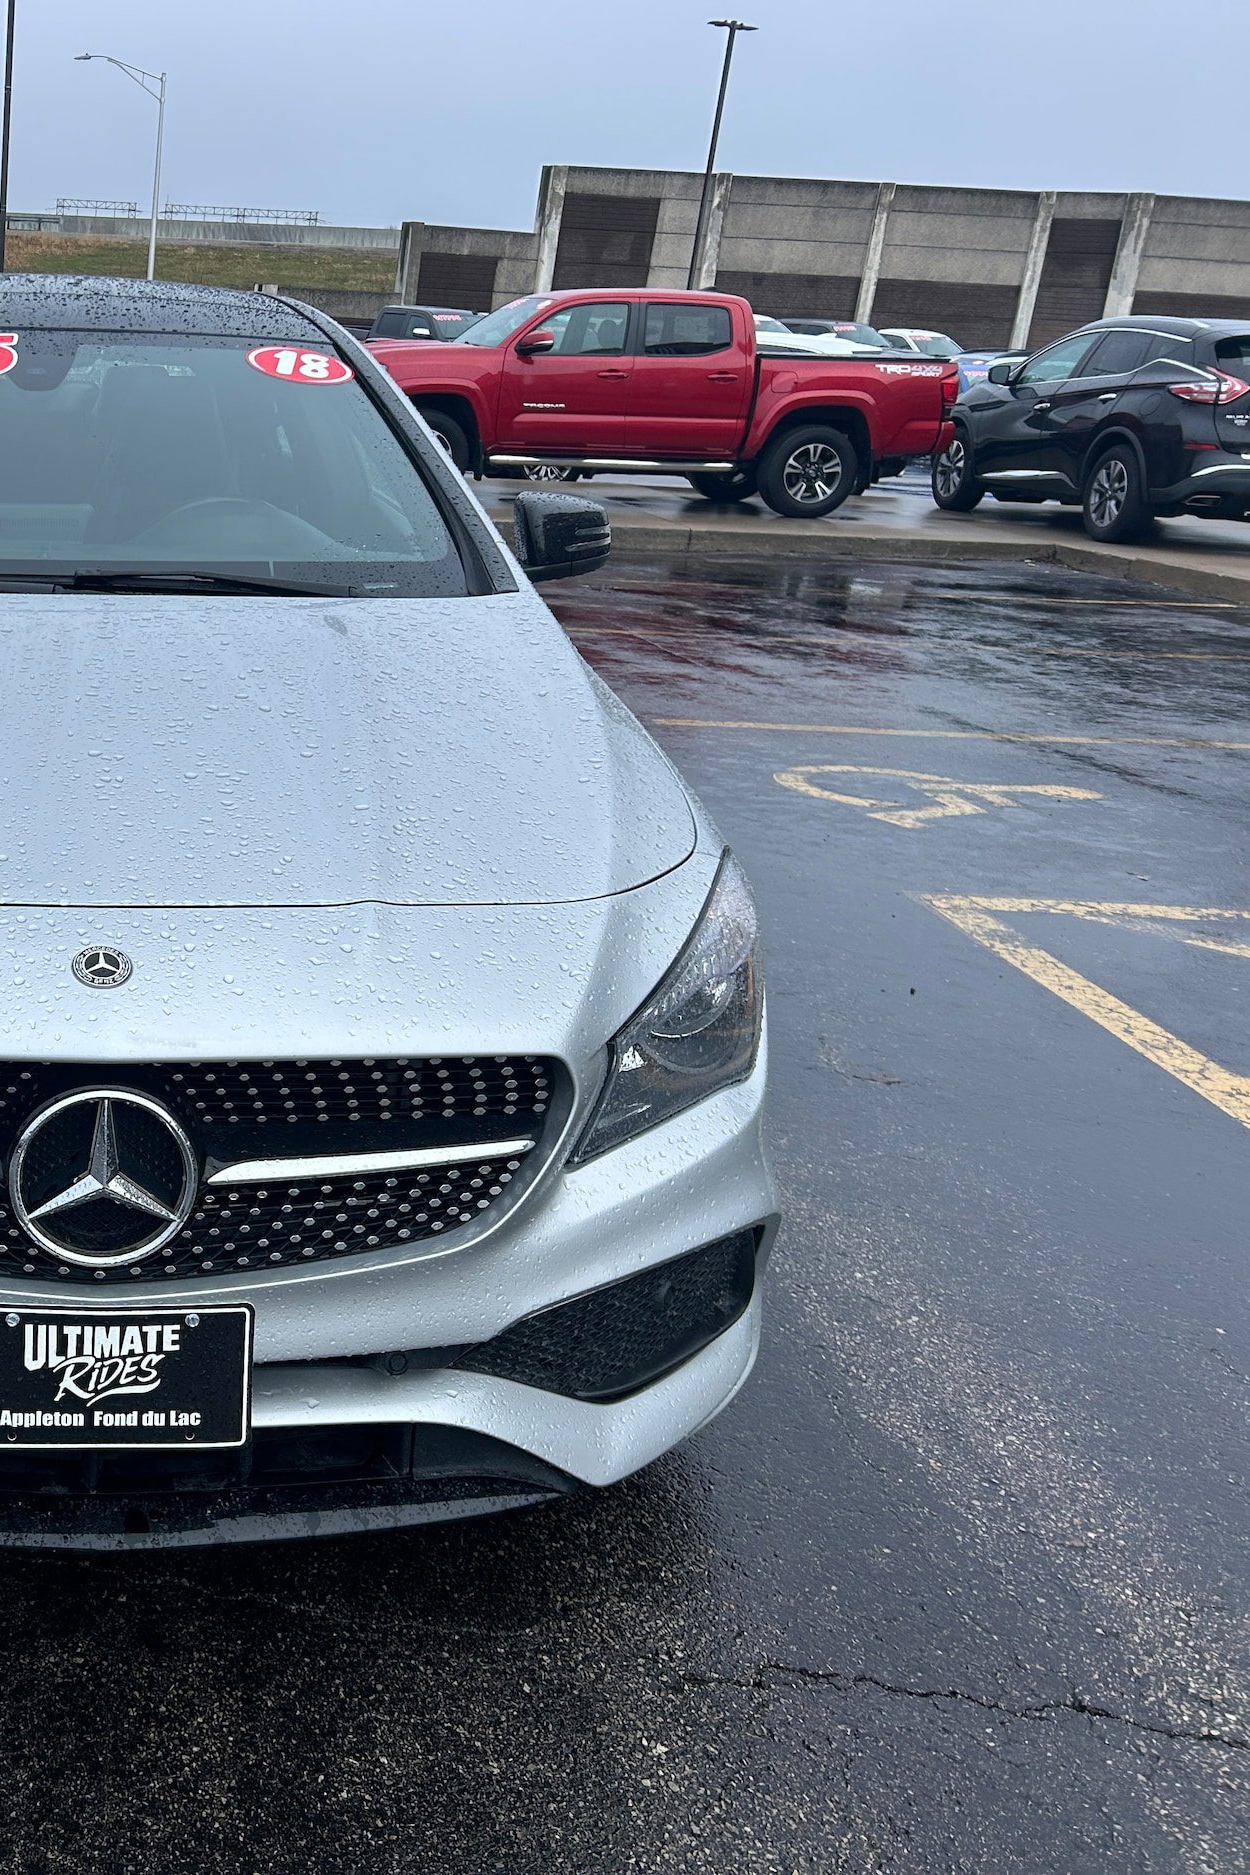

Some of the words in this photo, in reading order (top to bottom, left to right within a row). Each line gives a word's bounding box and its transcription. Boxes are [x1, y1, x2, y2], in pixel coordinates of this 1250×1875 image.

[273, 350, 330, 379] 18
[24, 1324, 181, 1371] ULTIMATE
[0, 1410, 84, 1427] Appleton
[94, 1410, 138, 1427] Fond
[141, 1410, 164, 1427] du
[169, 1410, 201, 1426] Lac
